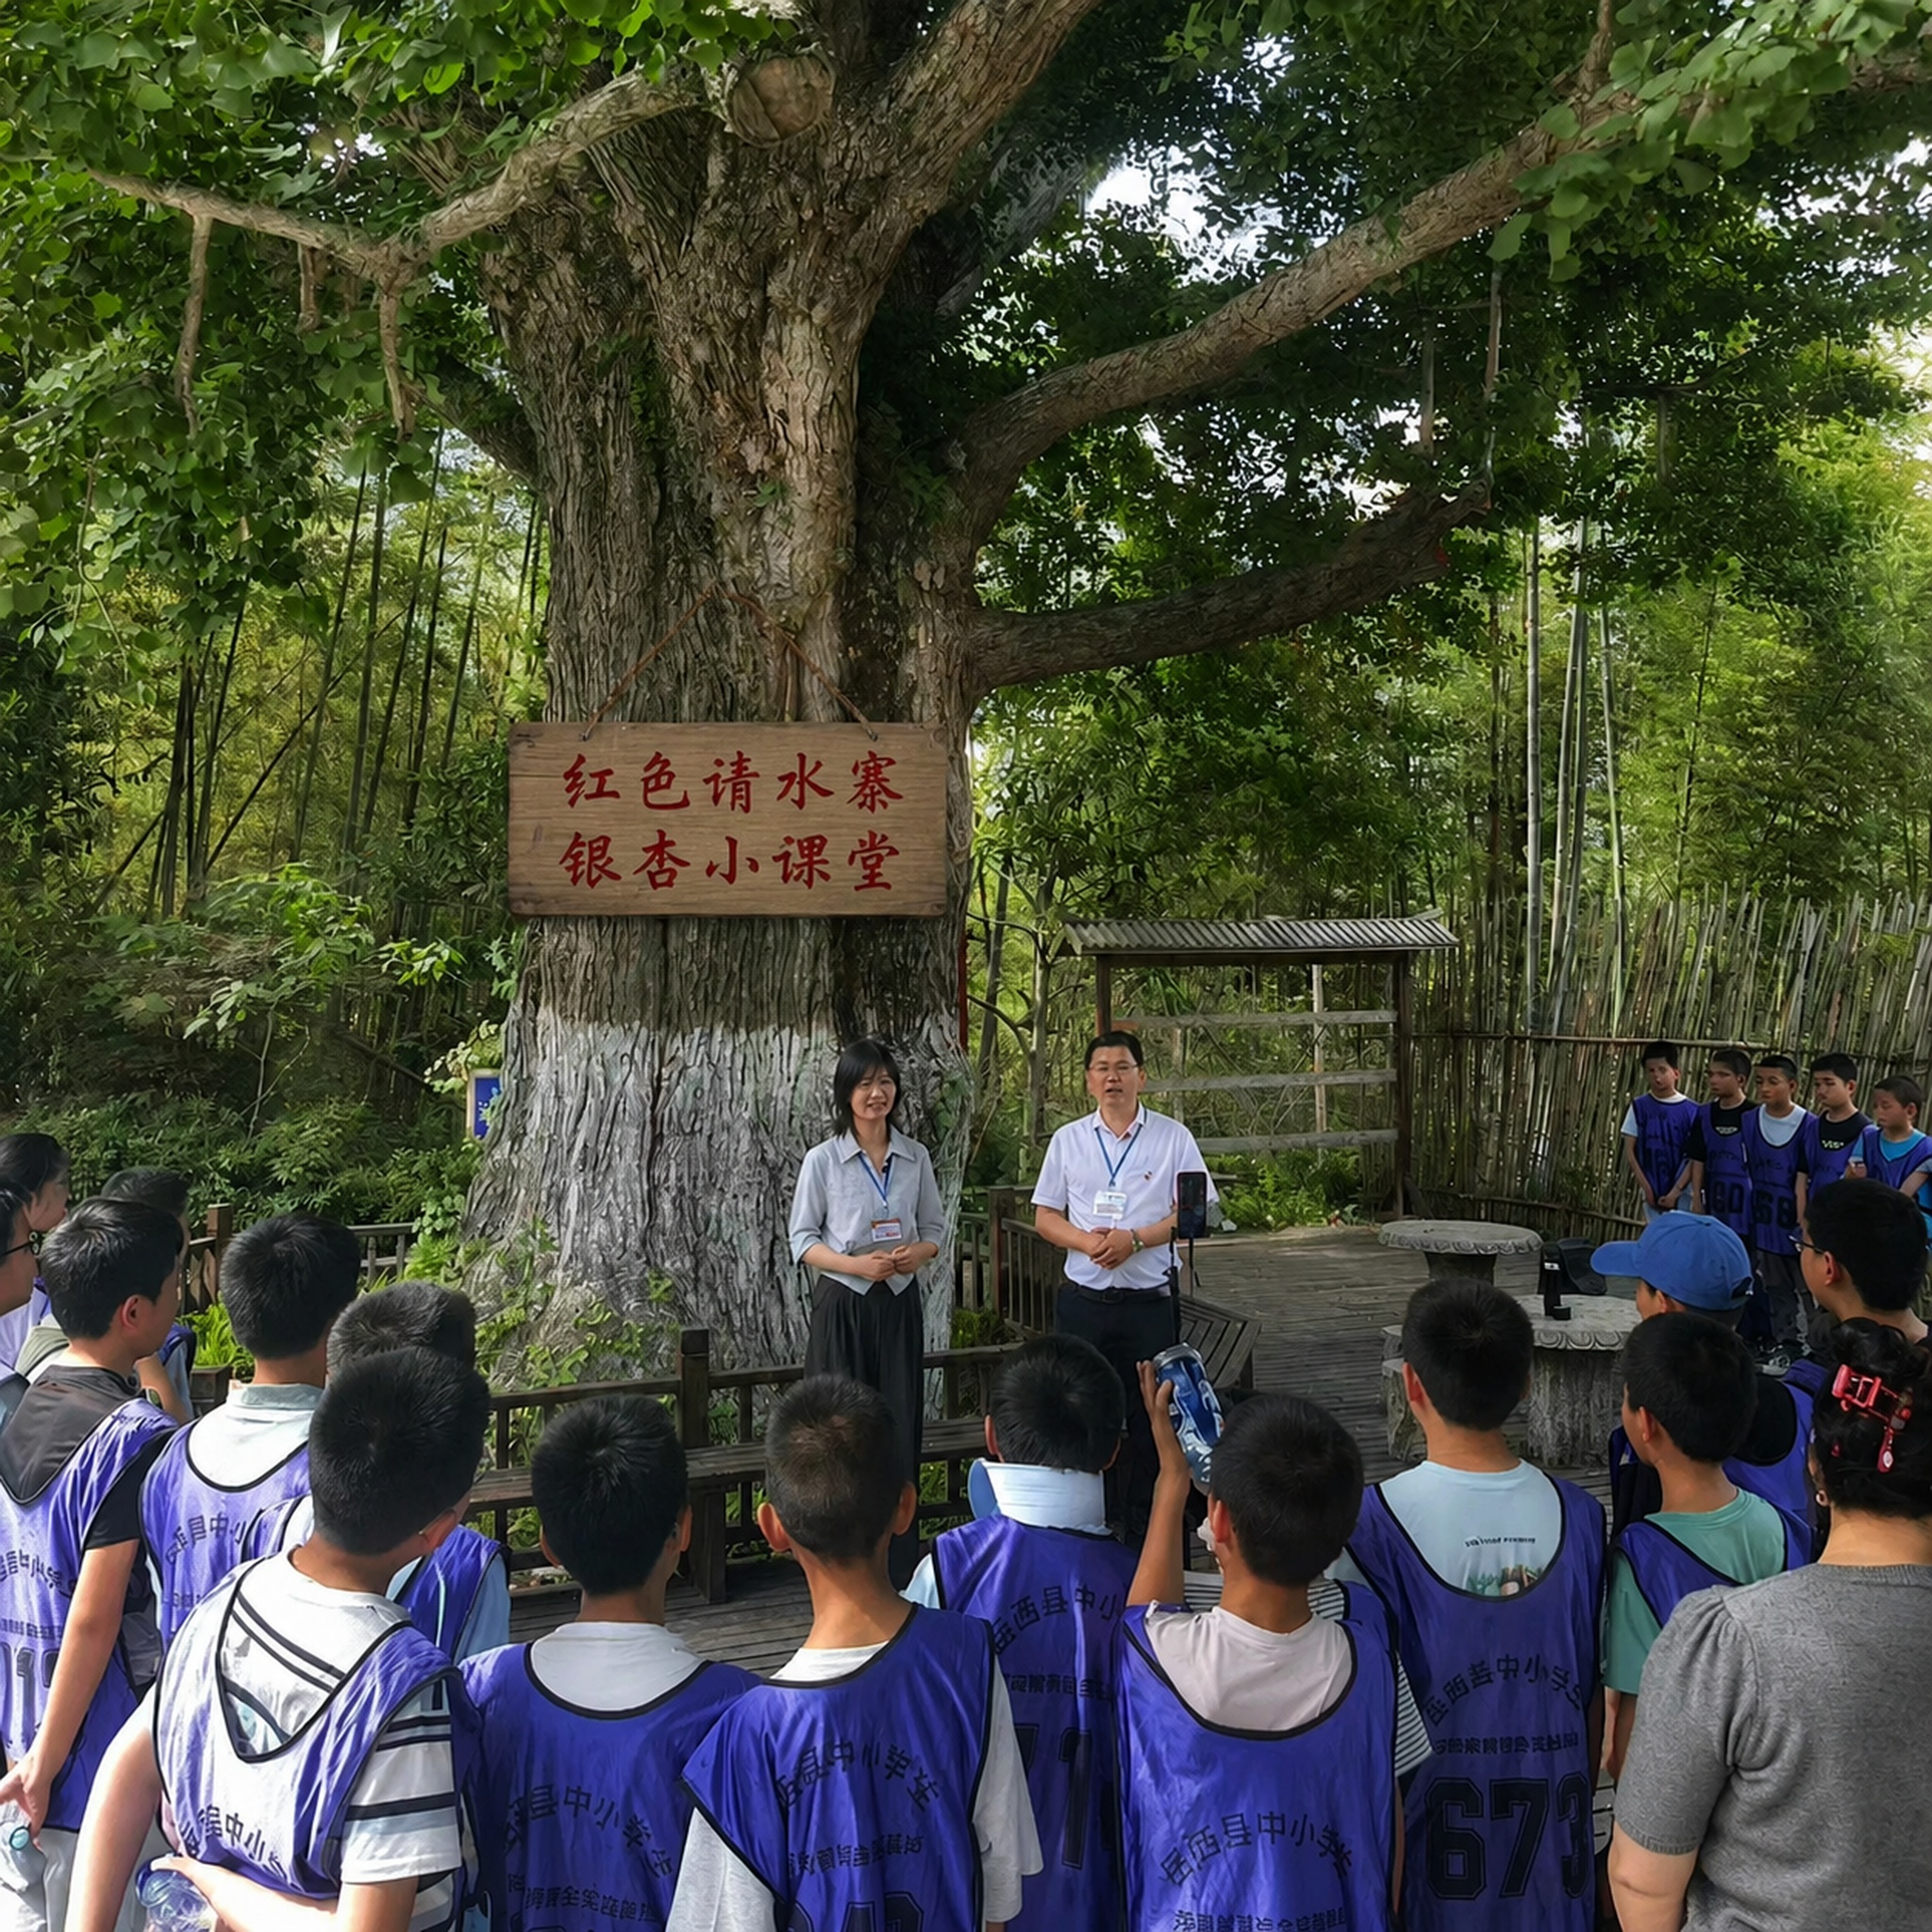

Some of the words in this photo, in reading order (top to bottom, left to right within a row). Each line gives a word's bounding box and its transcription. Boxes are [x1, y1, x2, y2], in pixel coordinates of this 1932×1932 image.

[562, 751, 904, 814] 红色请水寨
[558, 828, 901, 892] 银杏小课堂
[1425, 1770, 1591, 1902] 673
